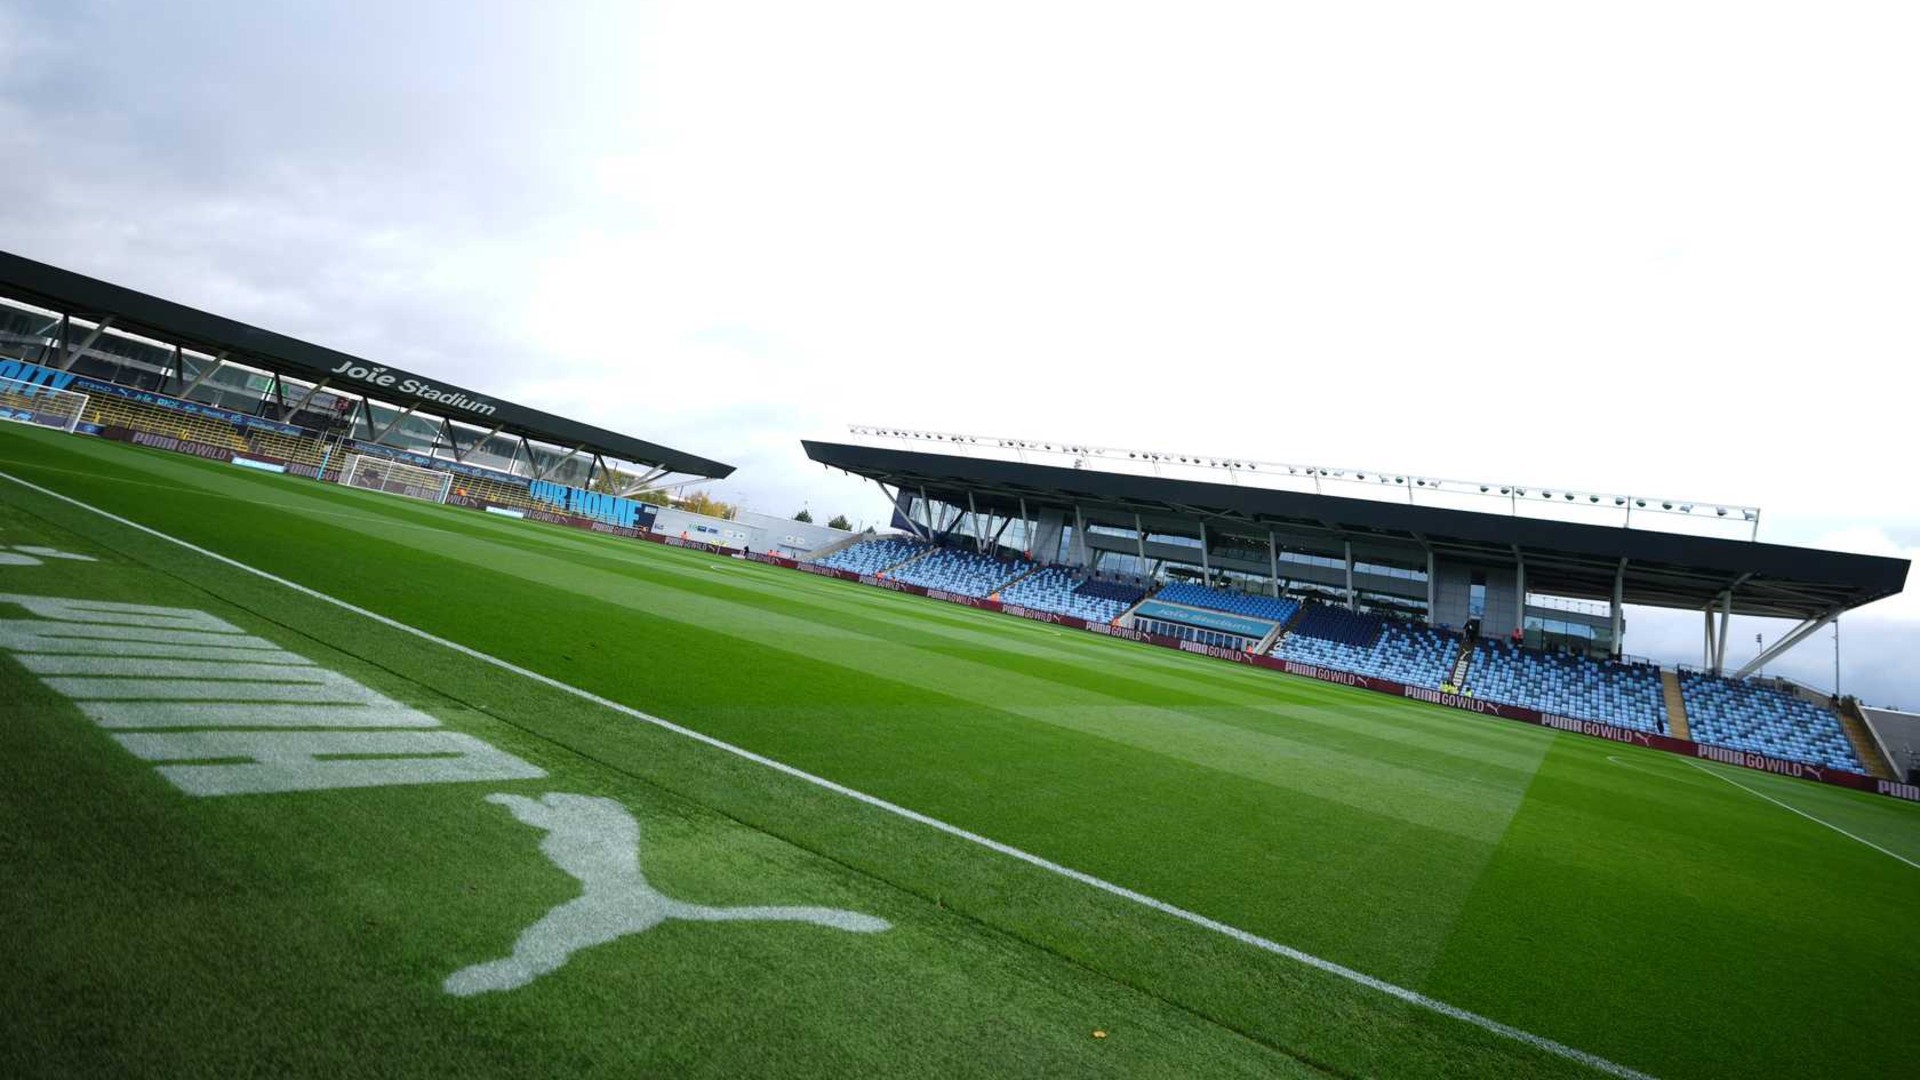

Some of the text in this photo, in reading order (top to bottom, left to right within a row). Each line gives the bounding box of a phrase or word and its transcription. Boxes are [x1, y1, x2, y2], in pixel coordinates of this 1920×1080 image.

[331, 361, 496, 416] Joie Stadium
[132, 431, 177, 450] PUMA
[530, 479, 642, 528] OUR HOME
[1002, 604, 1025, 617] PUMA
[1086, 621, 1111, 635] PUMA
[1191, 615, 1252, 631] Stadium
[1180, 640, 1208, 654] PUMA
[1285, 661, 1317, 677] PUMA
[1405, 686, 1441, 703] PUMA
[1541, 713, 1583, 733] PUMA
[1698, 744, 1745, 764] PUMA
